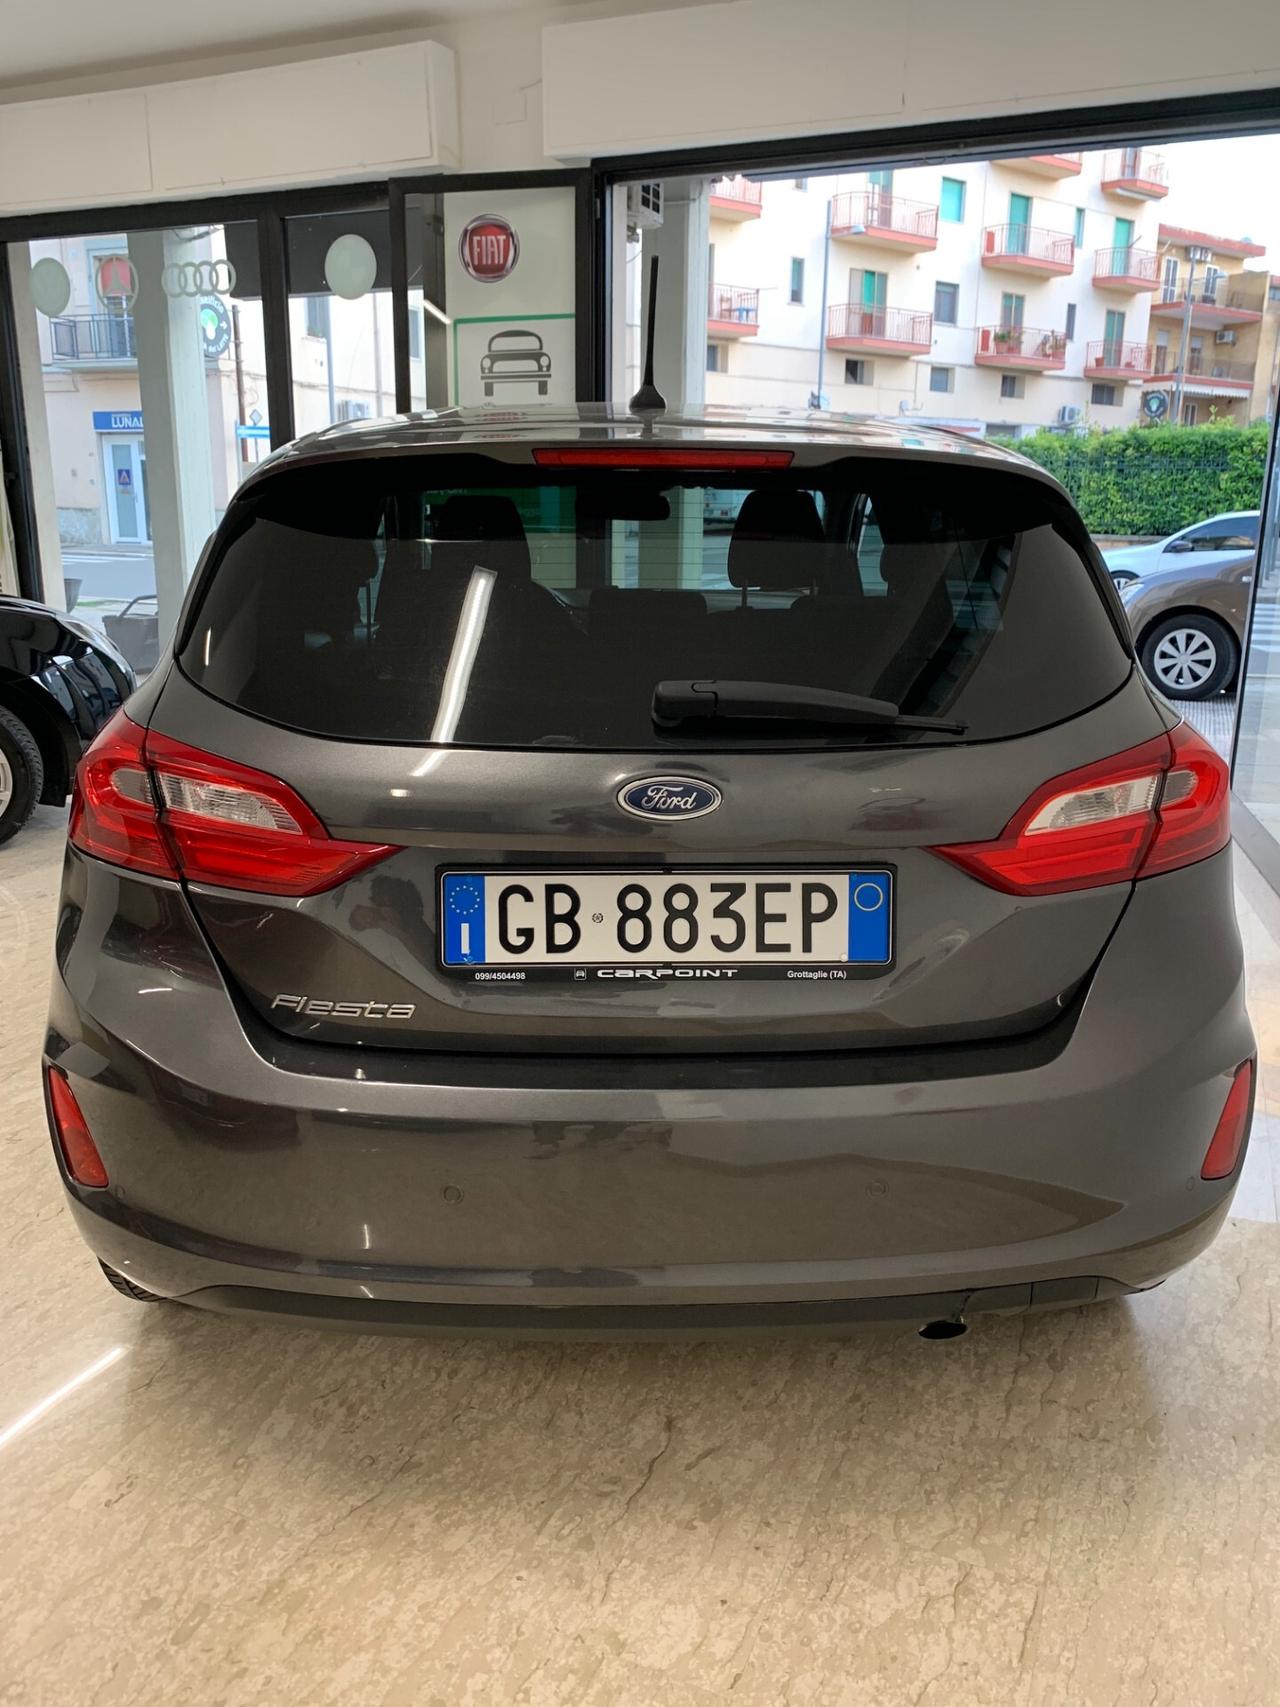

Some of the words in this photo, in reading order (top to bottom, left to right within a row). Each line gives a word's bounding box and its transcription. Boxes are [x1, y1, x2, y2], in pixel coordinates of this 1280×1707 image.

[472, 235, 506, 266] FIAT
[641, 785, 698, 810] Ford
[498, 883, 581, 954] GB
[616, 882, 838, 953] 883EP
[474, 972, 526, 981] 099/4504498
[597, 968, 738, 979] CARPOINT
[787, 969, 828, 980] Grottaglie
[829, 969, 847, 979] (TA)
[271, 993, 416, 1019] Fiesta
